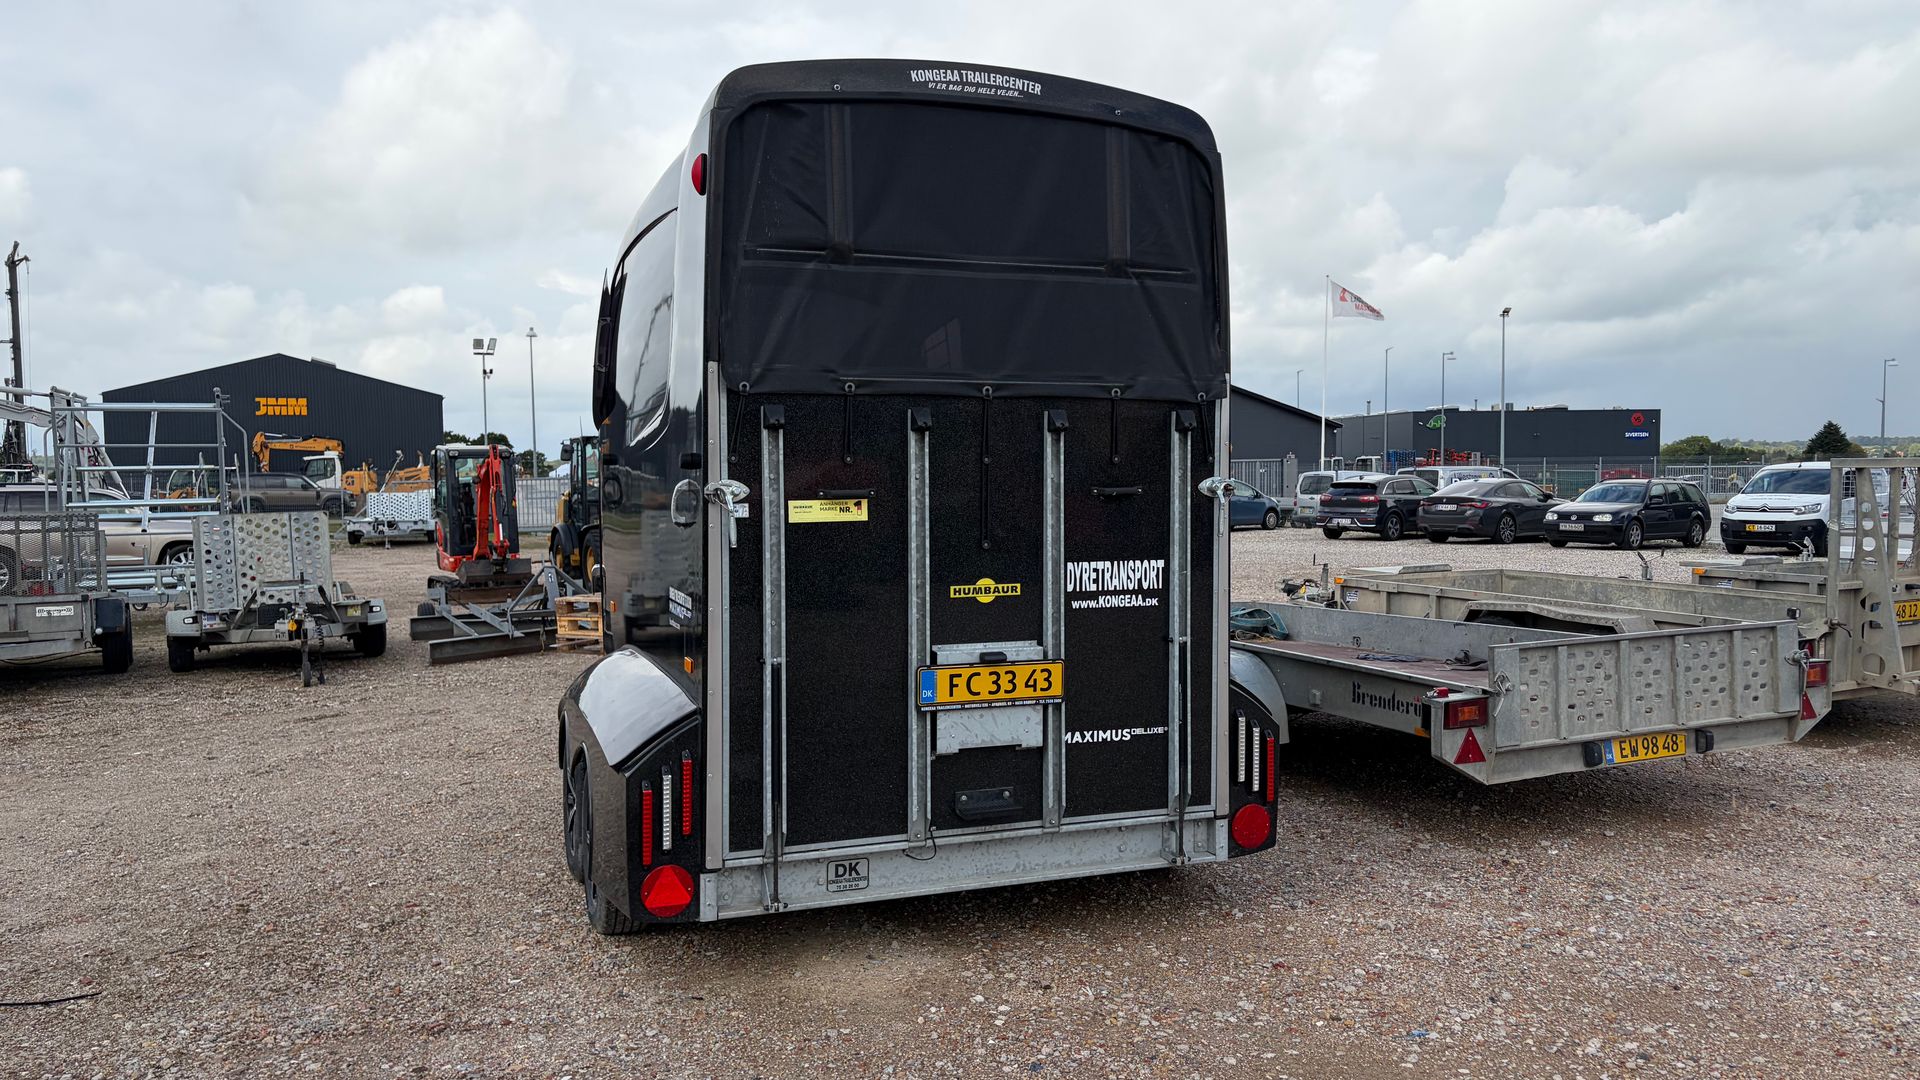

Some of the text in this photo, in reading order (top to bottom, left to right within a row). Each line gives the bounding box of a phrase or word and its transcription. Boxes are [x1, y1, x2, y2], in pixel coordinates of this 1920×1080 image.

[910, 69, 1042, 95] KONGEAA TRAILERCENTER
[978, 87, 995, 95] HELE
[255, 397, 307, 416] JMM
[1066, 560, 1164, 592] DYRETRANSPORT
[953, 586, 1018, 596] HUMBAUR
[1896, 604, 1918, 619] 48 12
[949, 668, 1052, 697] FC 33 43
[1619, 734, 1678, 758] EW 98 48
[835, 862, 860, 878] DK
